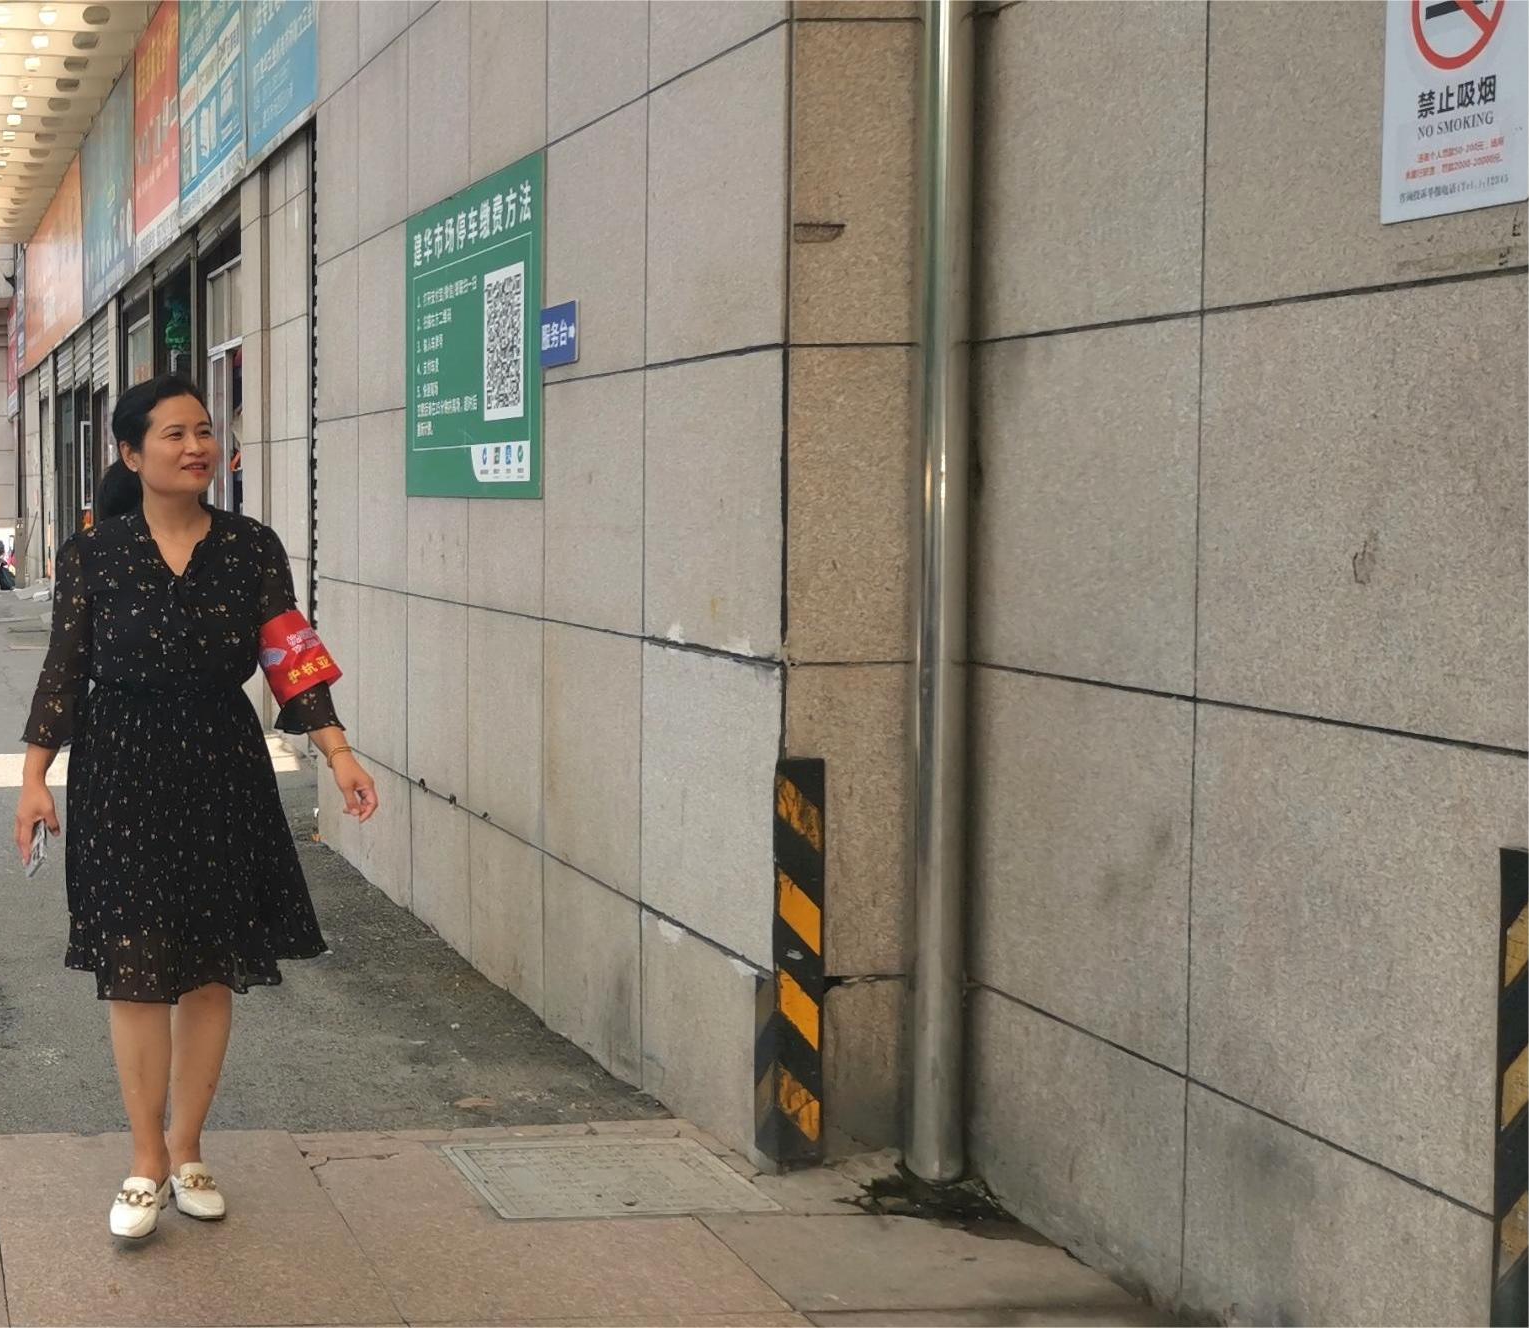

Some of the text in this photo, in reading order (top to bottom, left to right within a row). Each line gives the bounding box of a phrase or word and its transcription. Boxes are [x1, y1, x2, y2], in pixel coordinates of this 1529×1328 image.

[1417, 75, 1497, 120] 禁止吸烟
[1417, 111, 1494, 140] NO SMOKING
[413, 179, 532, 268] 建华市场停车缴费方法
[541, 317, 568, 351] 服务台
